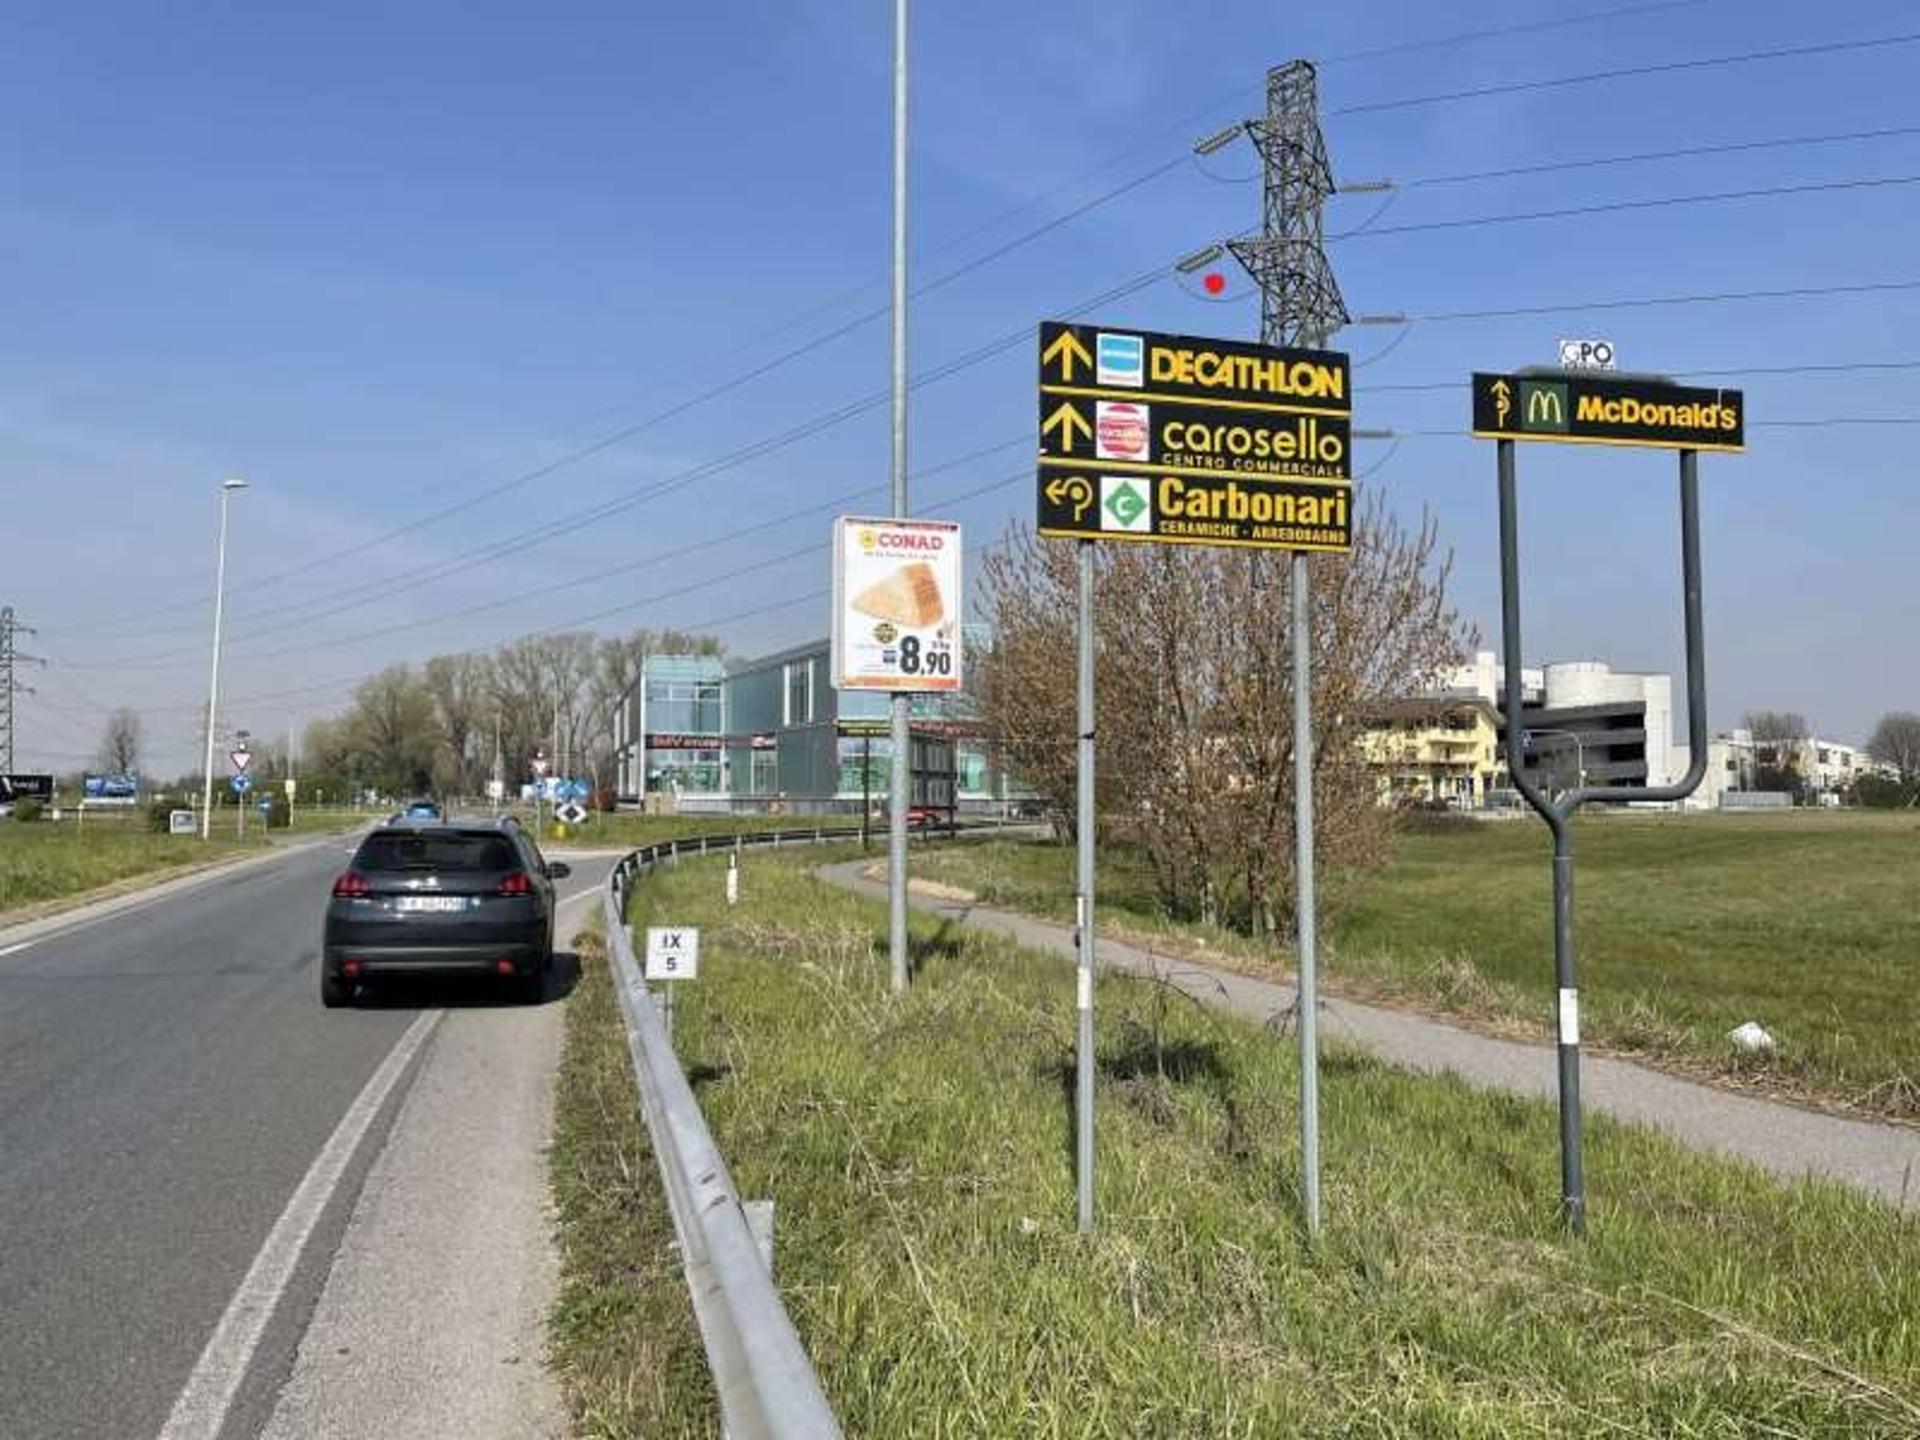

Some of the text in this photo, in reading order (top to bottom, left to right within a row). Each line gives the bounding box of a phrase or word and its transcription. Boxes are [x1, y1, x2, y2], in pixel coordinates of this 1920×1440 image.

[1151, 347, 1343, 399] DECATHLON
[1576, 395, 1737, 430] McDonald's
[1162, 416, 1343, 462] carosello
[1162, 453, 1345, 479] CENTRO COMMERCIALE
[1158, 477, 1346, 526] Carbonari
[878, 533, 944, 550] CONAD
[1159, 520, 1238, 538] CERAMICHE
[663, 933, 681, 949] IX
[666, 956, 677, 972] 5
